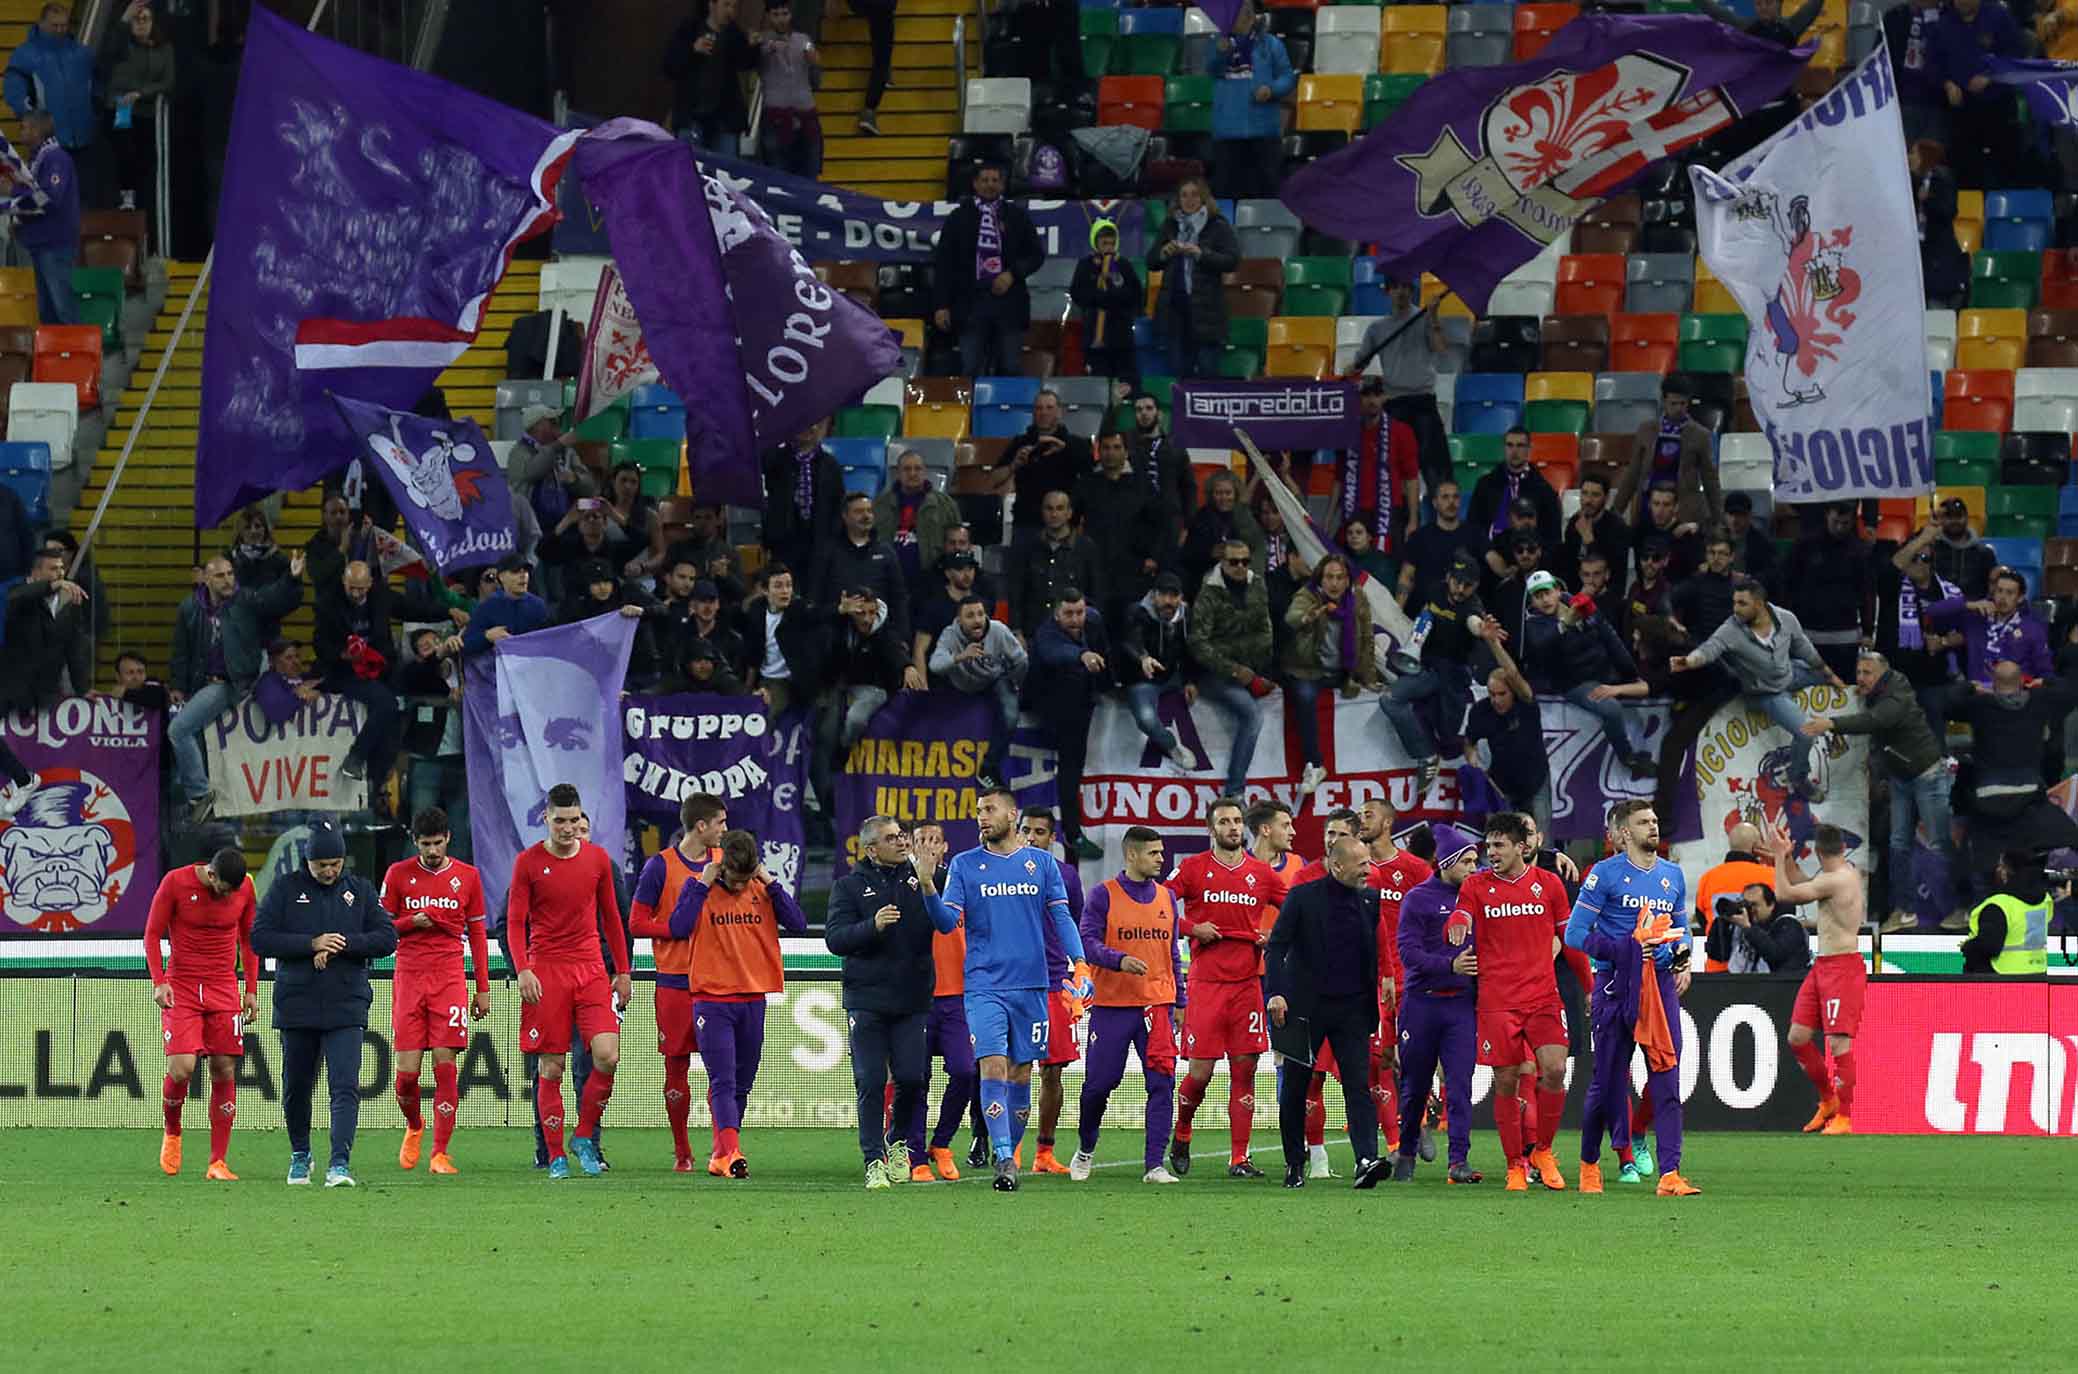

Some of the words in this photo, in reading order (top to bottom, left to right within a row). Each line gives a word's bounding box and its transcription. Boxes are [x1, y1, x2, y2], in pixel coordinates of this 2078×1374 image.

[0, 697, 149, 749] CLONE
[89, 736, 149, 748] VIOLA
[241, 755, 331, 806] VIVE
[981, 883, 1039, 897] folletto
[1203, 889, 1258, 906] folletto
[711, 912, 763, 926] folletto
[1484, 902, 1545, 919] folletto
[1118, 926, 1169, 941] folletto
[449, 1006, 469, 1028] 28
[1826, 998, 1841, 1020] 17
[1032, 1020, 1050, 1044] 57
